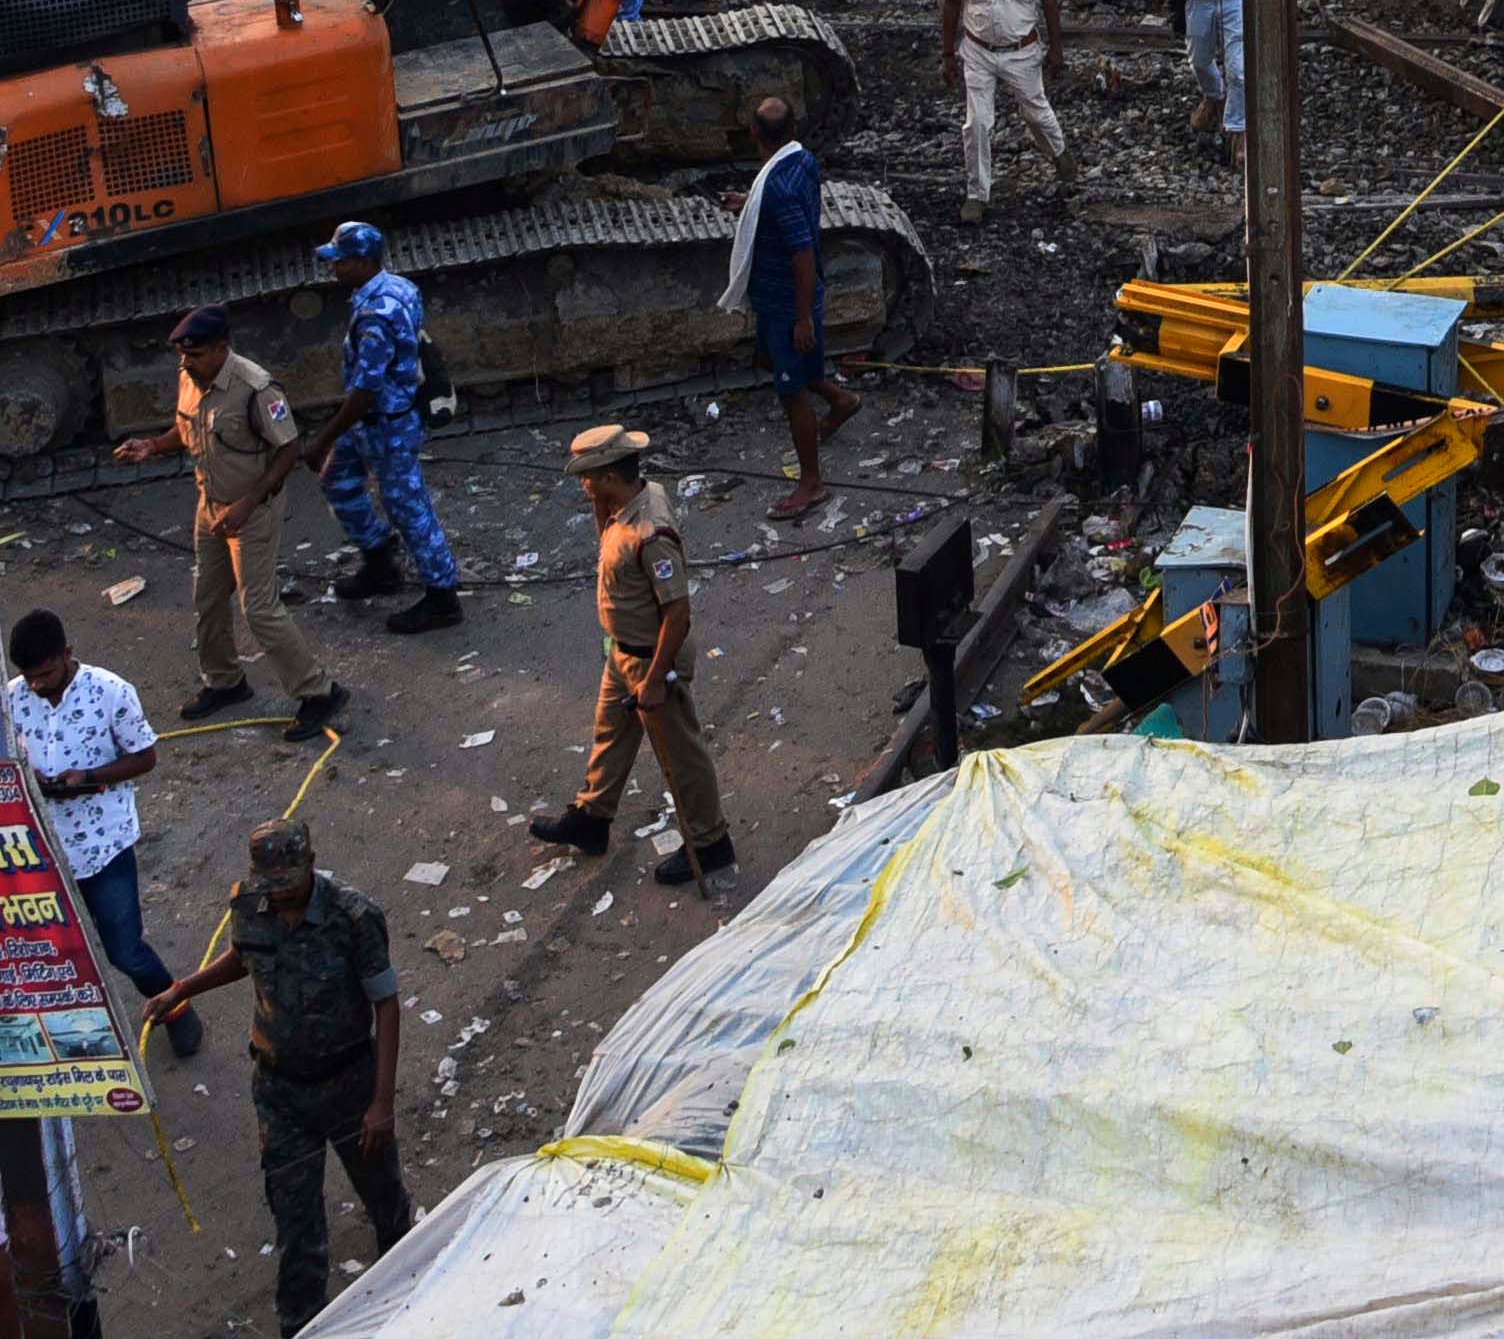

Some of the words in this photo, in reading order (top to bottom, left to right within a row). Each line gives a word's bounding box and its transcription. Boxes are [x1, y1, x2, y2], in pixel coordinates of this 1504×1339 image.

[0, 890, 65, 927] भवन
[72, 1064, 93, 1084] मिल
[94, 1067, 106, 1082] के
